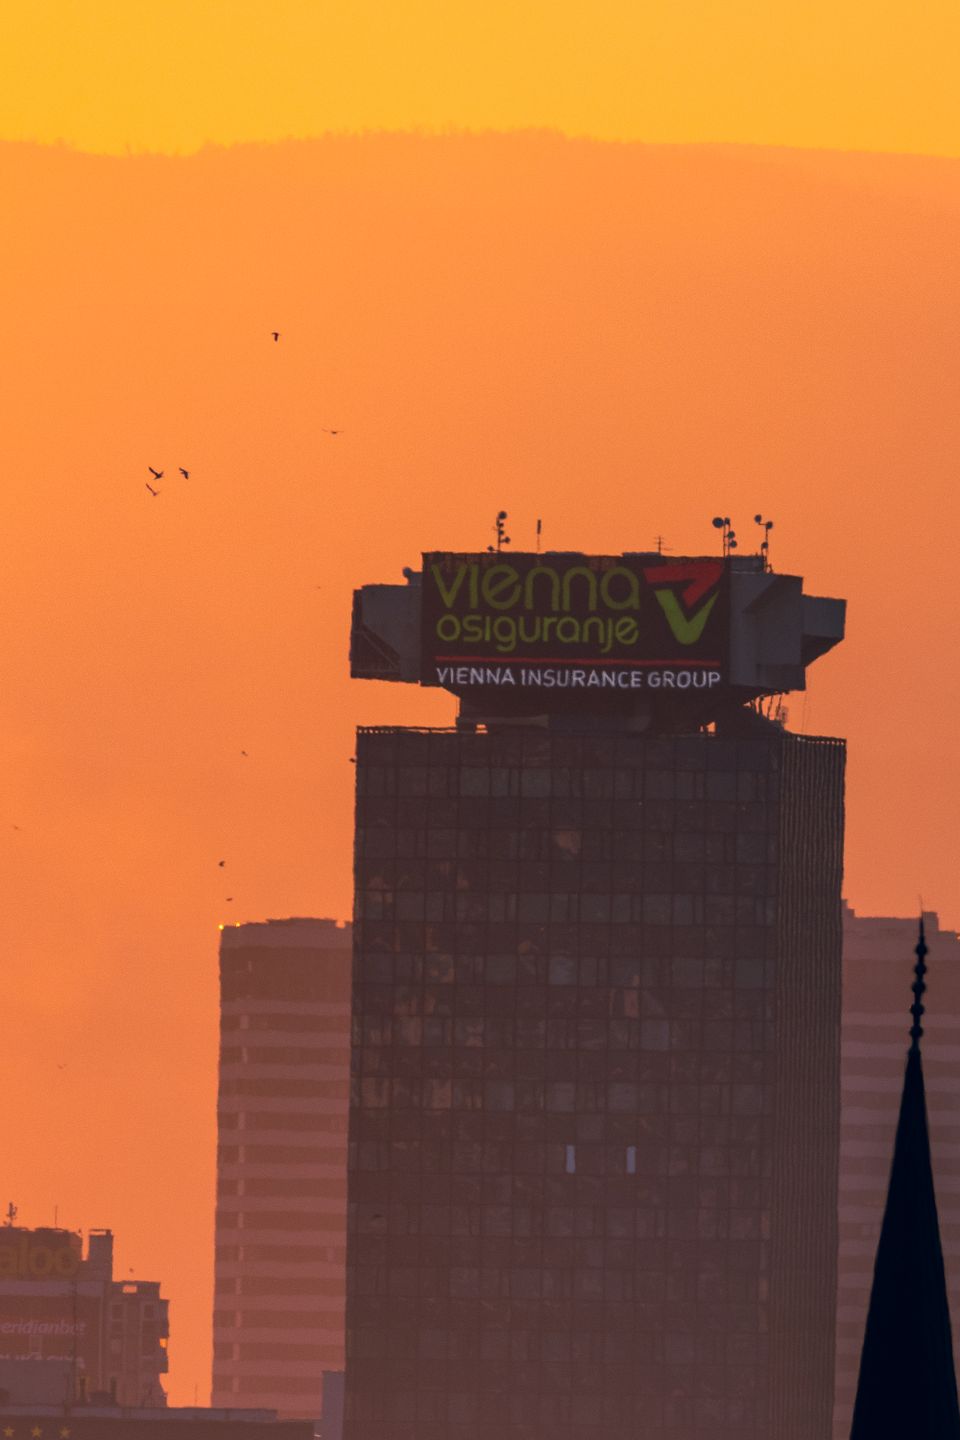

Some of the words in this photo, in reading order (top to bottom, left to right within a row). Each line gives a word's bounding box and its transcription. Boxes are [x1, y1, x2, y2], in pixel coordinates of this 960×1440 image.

[436, 615, 640, 653] osiguranje
[436, 667, 516, 686] VIENNA
[521, 668, 641, 688] INSURANCE
[647, 670, 721, 688] GROUP
